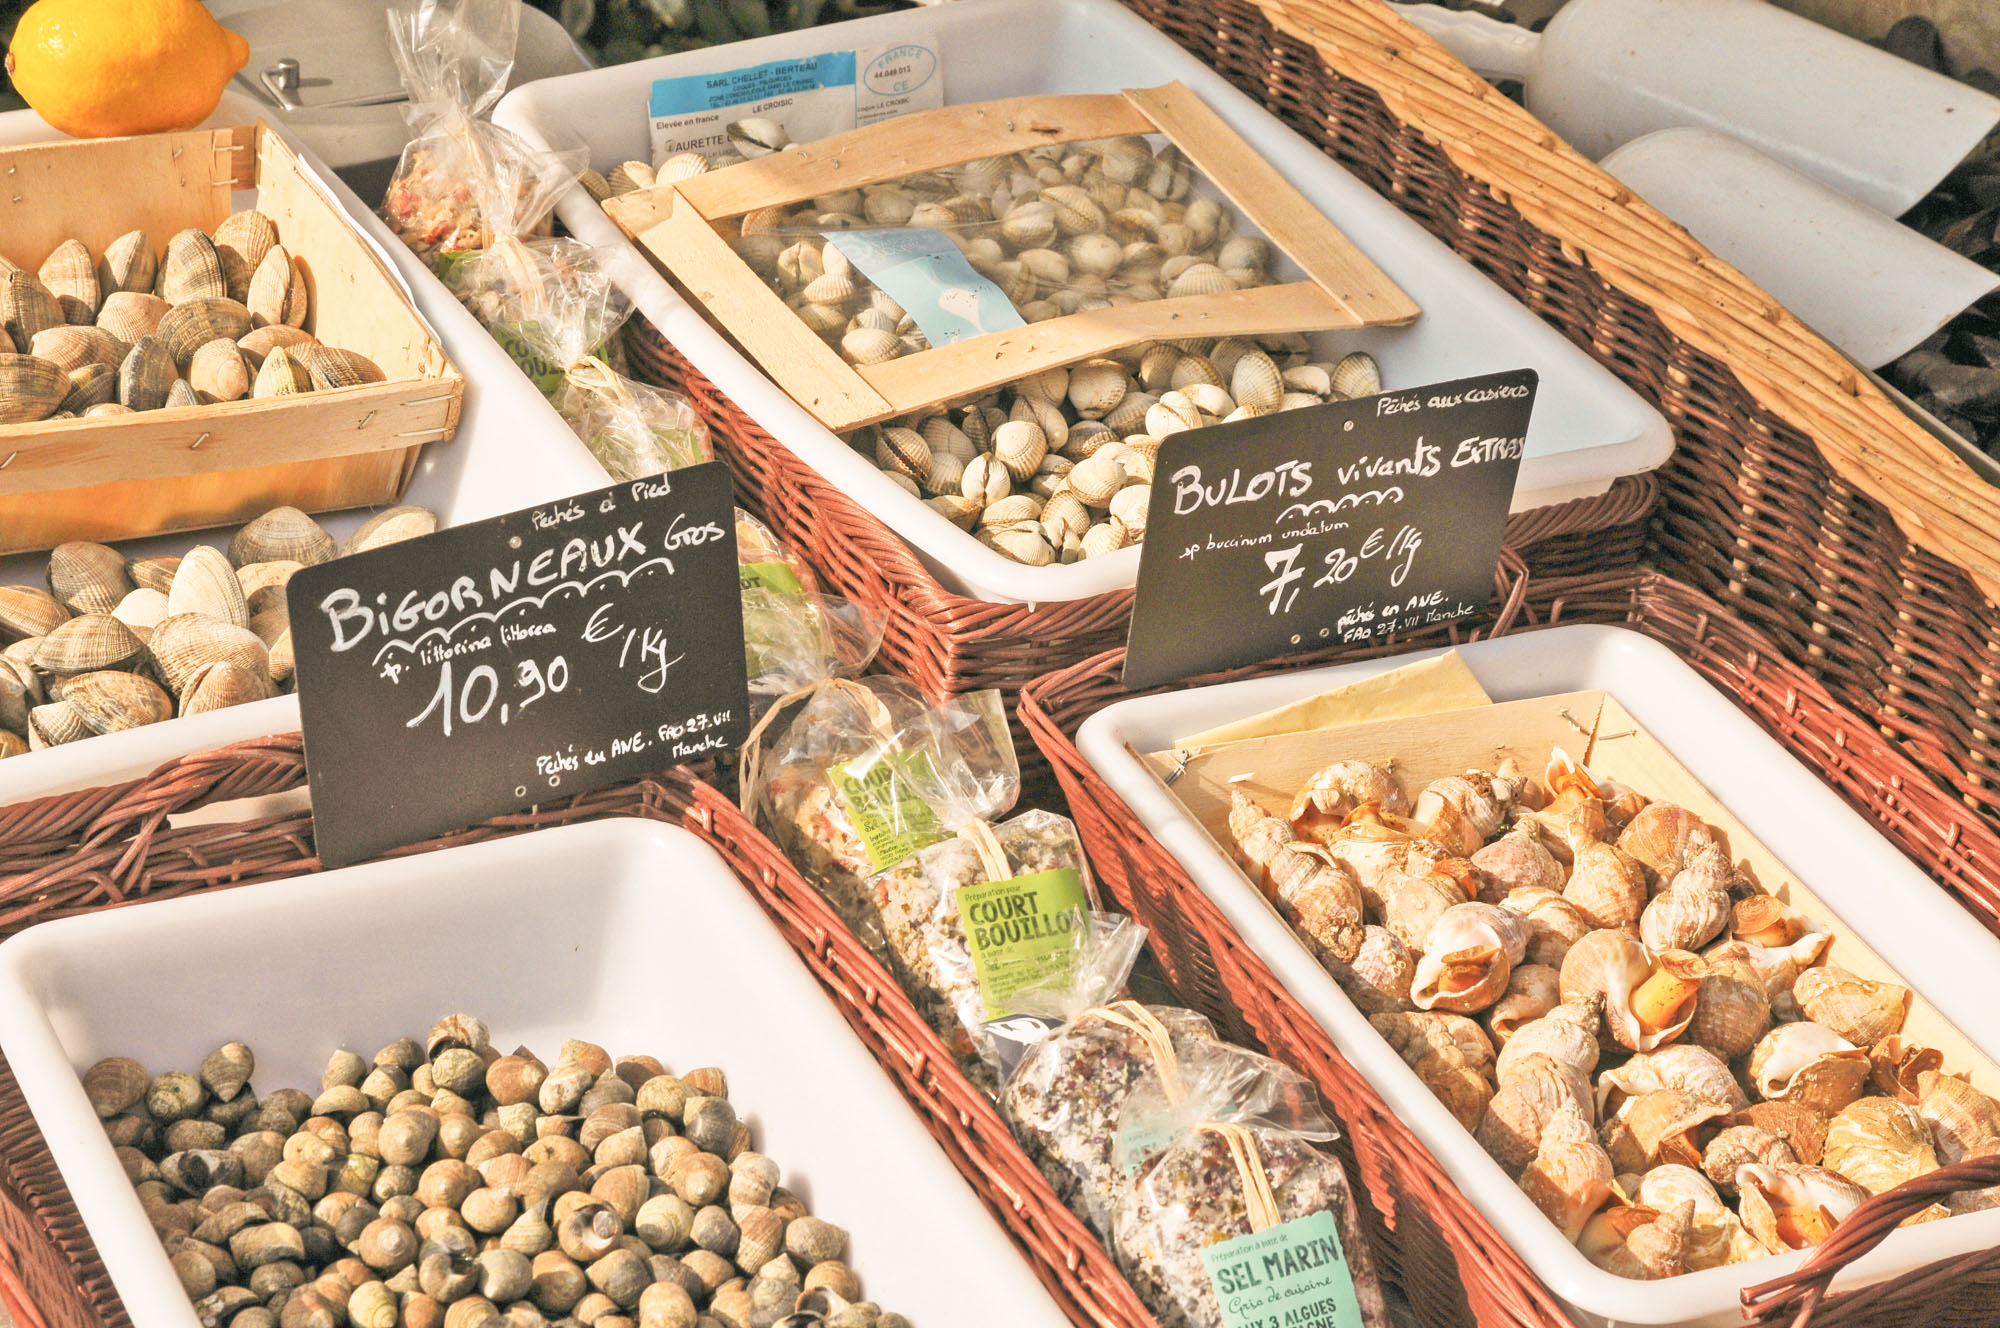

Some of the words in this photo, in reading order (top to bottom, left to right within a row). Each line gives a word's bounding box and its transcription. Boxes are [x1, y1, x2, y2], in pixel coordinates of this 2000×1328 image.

[877, 47, 922, 69] FRANCE
[706, 78, 729, 88] SARL
[775, 62, 818, 75] BERTEAU
[893, 80, 909, 92] CE
[684, 118, 694, 126] en
[695, 114, 720, 123] france
[752, 105, 762, 113] LE
[762, 98, 793, 110] CROISIC
[1428, 394, 1463, 409] aux
[1337, 436, 1441, 486] vivants
[632, 472, 671, 502] Pied
[1206, 533, 1273, 550] buccinum
[1281, 520, 1349, 540] undatum
[1343, 625, 1372, 644] FAO
[1425, 602, 1474, 624] Manche
[1381, 604, 1400, 618] en
[420, 635, 492, 666] littorina
[500, 623, 557, 648] littorea
[406, 655, 569, 737] 10,90
[672, 734, 729, 759] Manche
[969, 891, 1038, 925] COURT
[1217, 1261, 1262, 1294] SEL
[1262, 1235, 1339, 1281] MARIN
[1228, 1297, 1265, 1320] Gris
[1265, 1286, 1282, 1303] de
[1284, 1276, 1333, 1298] cuisine
[1269, 1315, 1280, 1328] 3
[1284, 1298, 1337, 1327] ALGUES
